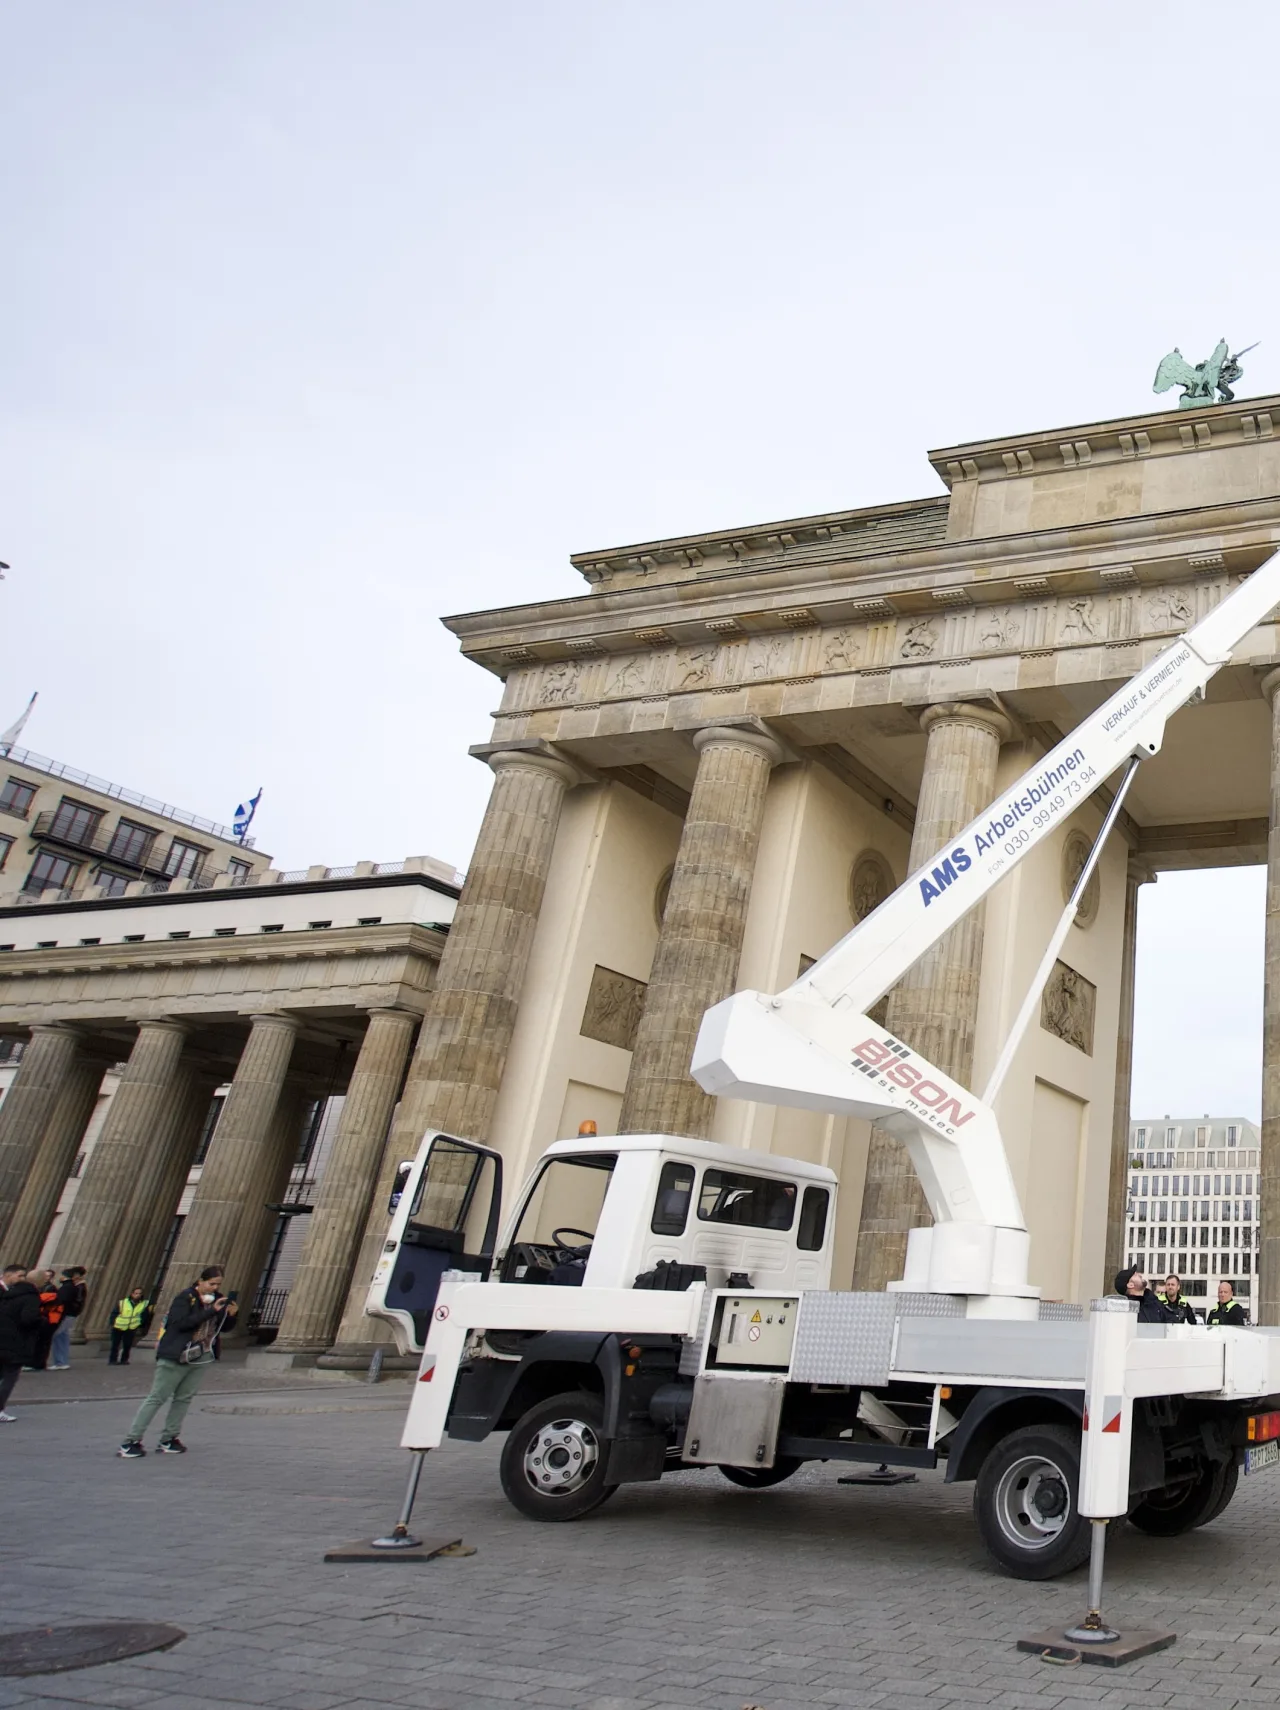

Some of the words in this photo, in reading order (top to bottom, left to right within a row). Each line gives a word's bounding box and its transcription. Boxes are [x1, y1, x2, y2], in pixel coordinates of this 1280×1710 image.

[1102, 695, 1139, 732] VERKAUF
[1139, 689, 1147, 700] &
[1144, 649, 1191, 693] VERMIETUNG
[919, 847, 972, 907] AMS
[974, 748, 1086, 857] Arbeitsbühnen
[851, 1037, 976, 1128] BISON
